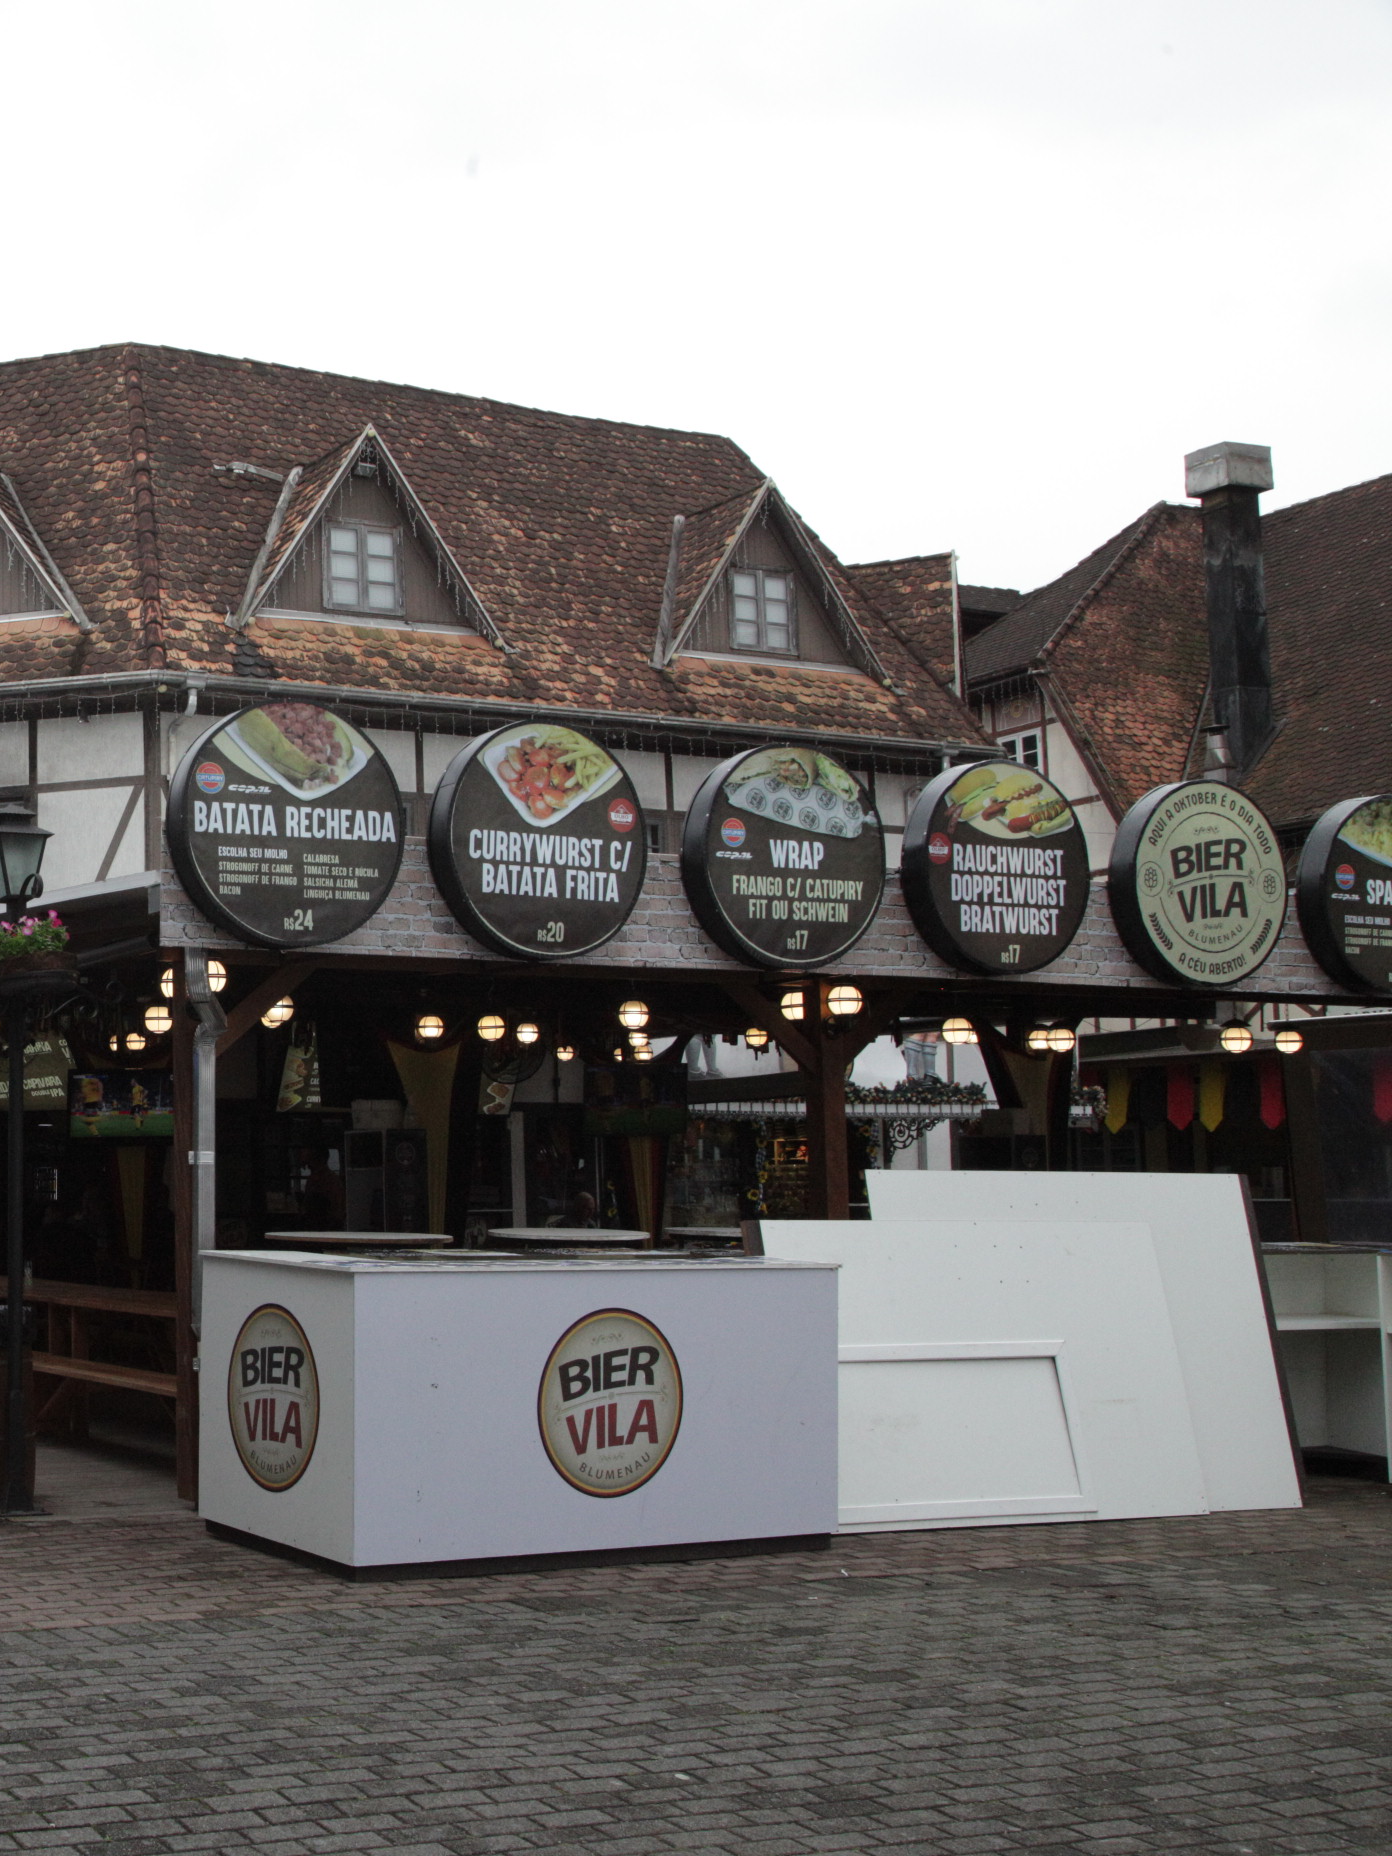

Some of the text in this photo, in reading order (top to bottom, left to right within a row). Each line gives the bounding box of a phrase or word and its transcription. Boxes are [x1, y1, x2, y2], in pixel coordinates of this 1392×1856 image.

[194, 800, 397, 843] BATATA RECHEADA
[1148, 792, 1272, 856] AQUI A OKTOBER É O DIA TODO
[217, 846, 288, 860] ESCOLHA SEU MOLHO
[303, 853, 340, 864] CALABRESA
[468, 828, 632, 872] CURRYWURST C/
[769, 838, 825, 870] WRAP
[952, 843, 1064, 877] RAUCHWURST
[1170, 838, 1247, 880] BIER
[218, 861, 294, 874] STROGONOFF DE CARNE
[218, 873, 298, 886] STROGONOFF DE FRANGO
[303, 865, 379, 878] TOMATE SECO E RÚCULA
[219, 885, 241, 896] BACON
[303, 877, 359, 889] SALSICHA ALEMÃ
[303, 888, 370, 901] LINGUIÇA BLUMENAU
[481, 862, 620, 904] BATATA FRITA
[732, 874, 864, 901] FRANGO C/ CATUPIRY
[951, 873, 1067, 907] DOPPELWURST
[748, 898, 849, 923] FIT OU SCHWEIN
[1177, 881, 1249, 924] VILA
[283, 908, 314, 931] R$24
[537, 921, 565, 943] R$20
[960, 904, 1059, 936] BRATWURST
[787, 930, 809, 950] R$17
[1187, 923, 1244, 945] BLUMENAU
[1001, 944, 1021, 964] R$17
[1178, 952, 1247, 975] A CÉU ABERTO!
[50, 1087, 66, 1098] IPA
[241, 1345, 305, 1389] BIER
[559, 1345, 660, 1403] BIER
[243, 1397, 303, 1450] VILA
[565, 1399, 659, 1456] VILA
[249, 1450, 298, 1475] BLUMENAU
[579, 1451, 651, 1480] BLUMENAU
